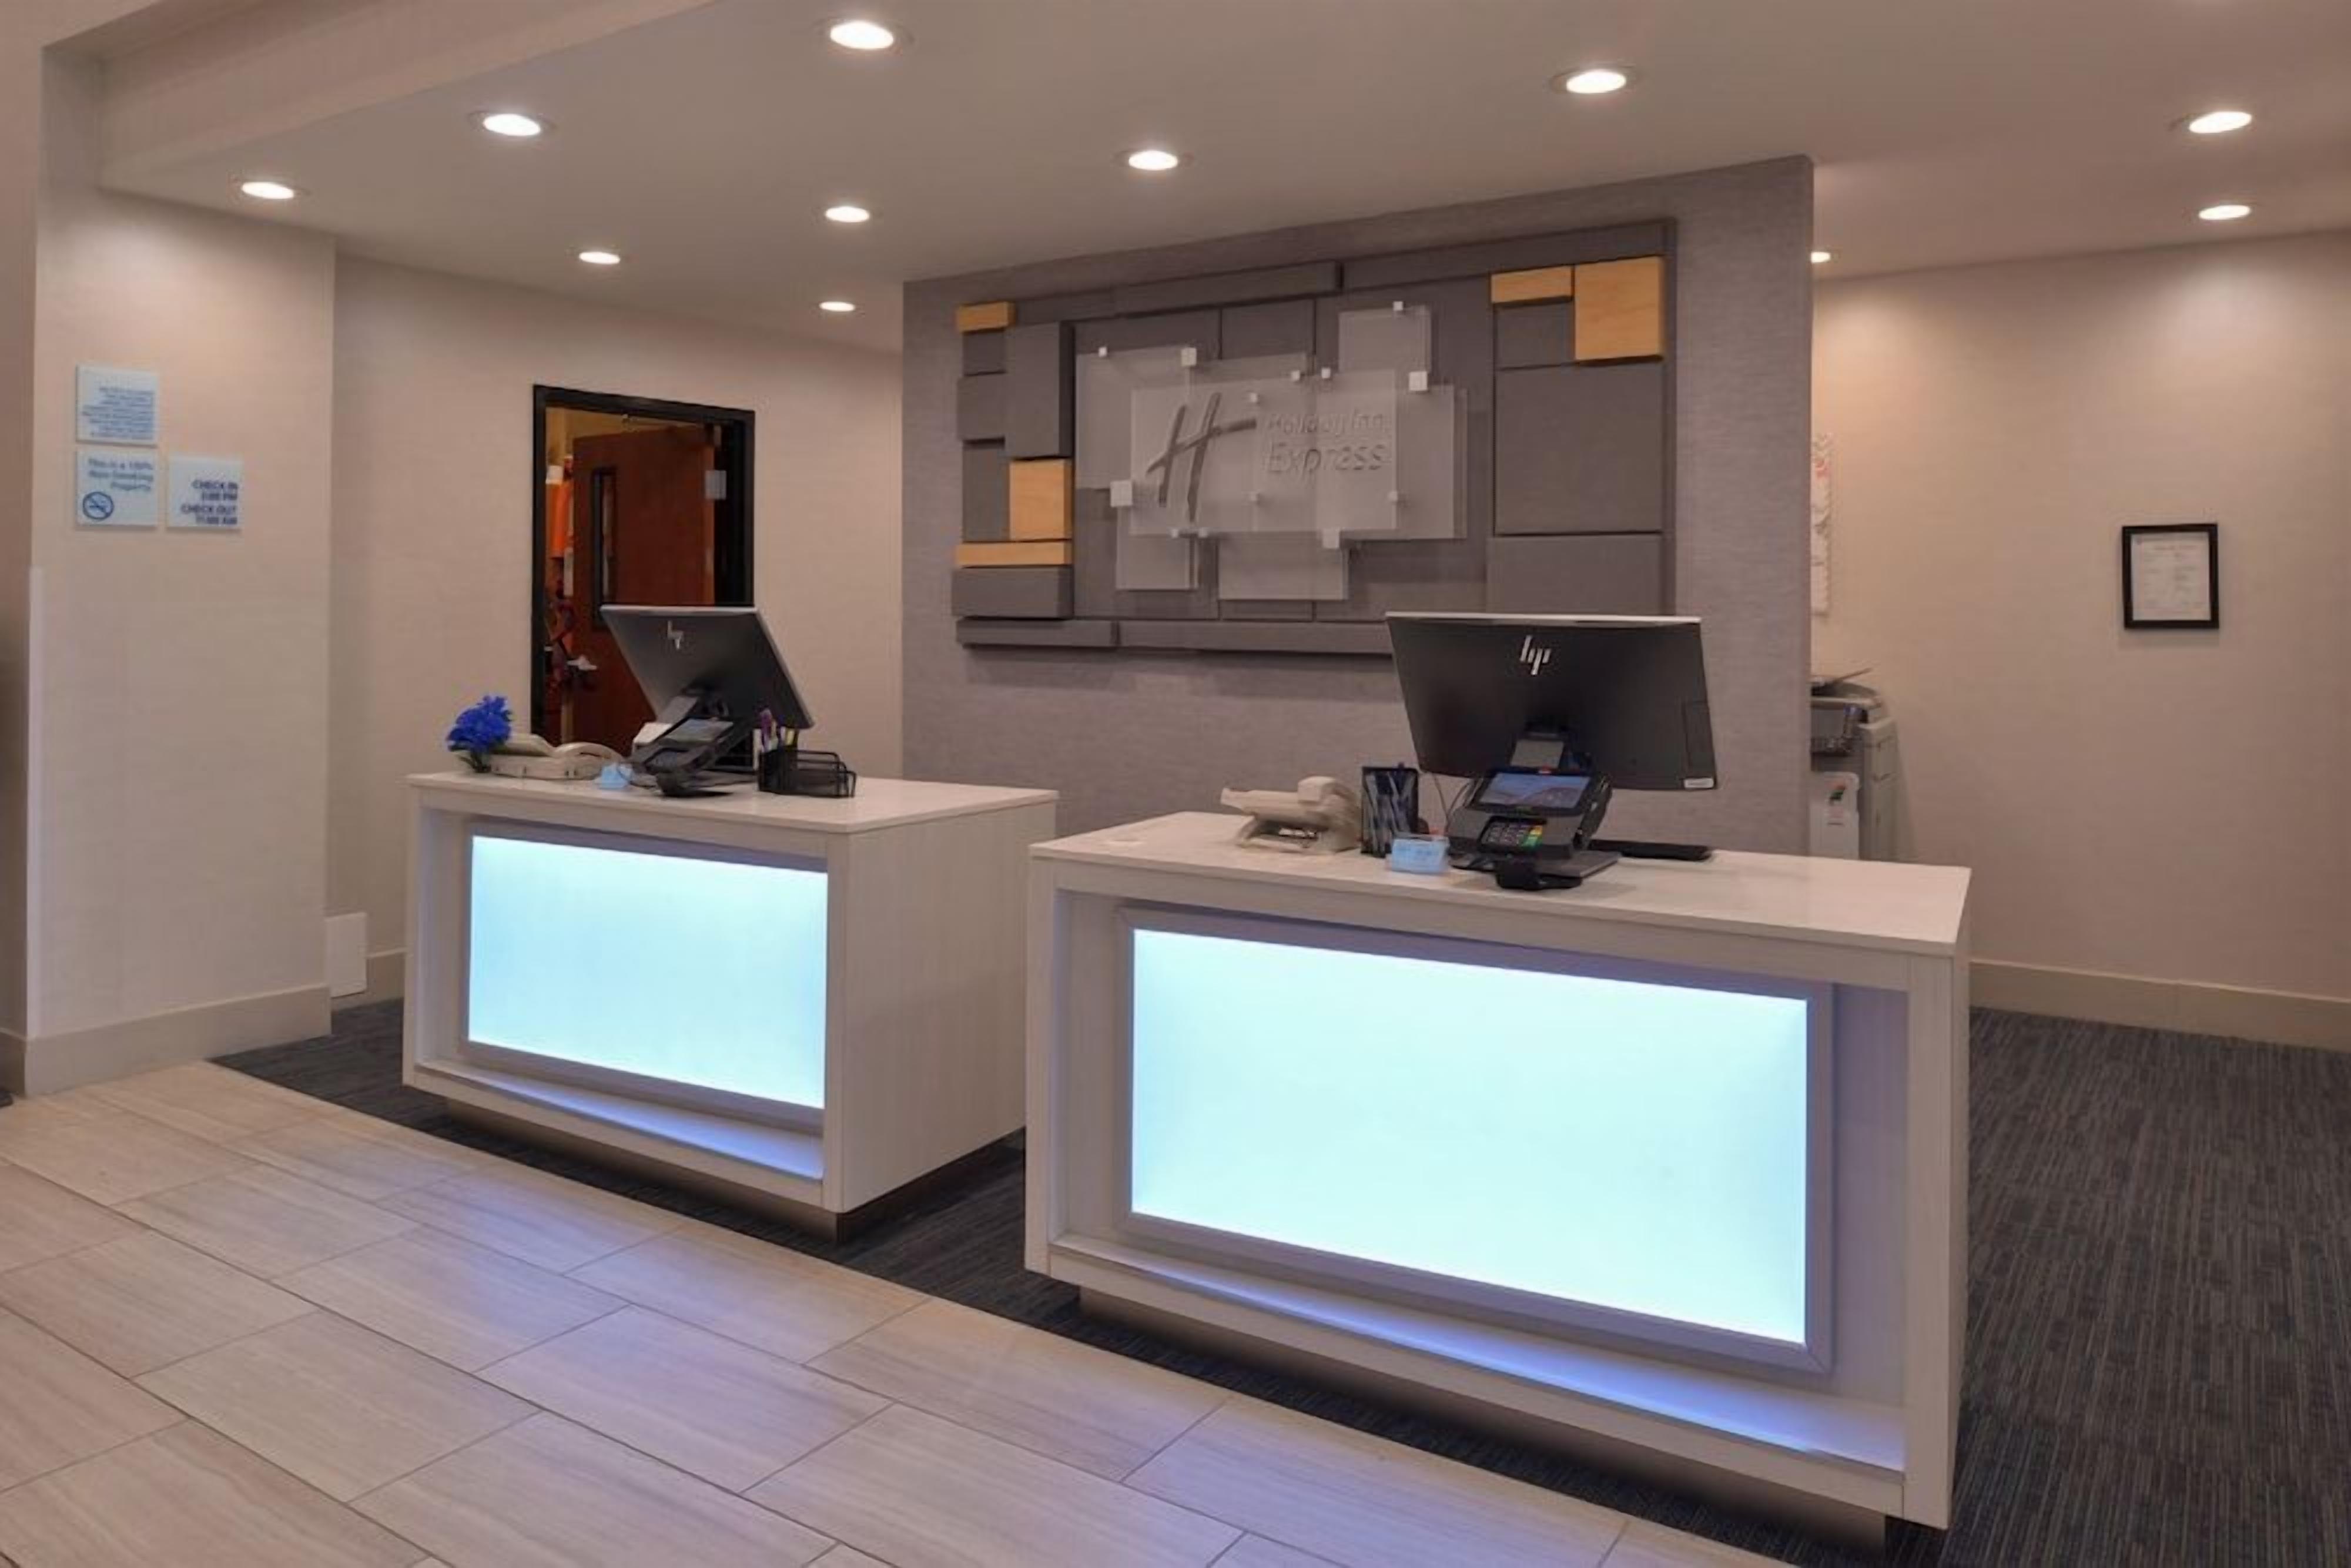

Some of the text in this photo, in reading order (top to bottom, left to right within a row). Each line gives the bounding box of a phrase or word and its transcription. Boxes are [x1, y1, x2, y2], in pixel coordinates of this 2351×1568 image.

[1267, 442, 1386, 478] Express
[191, 480, 224, 489] CHECK
[180, 503, 212, 514] CHECK
